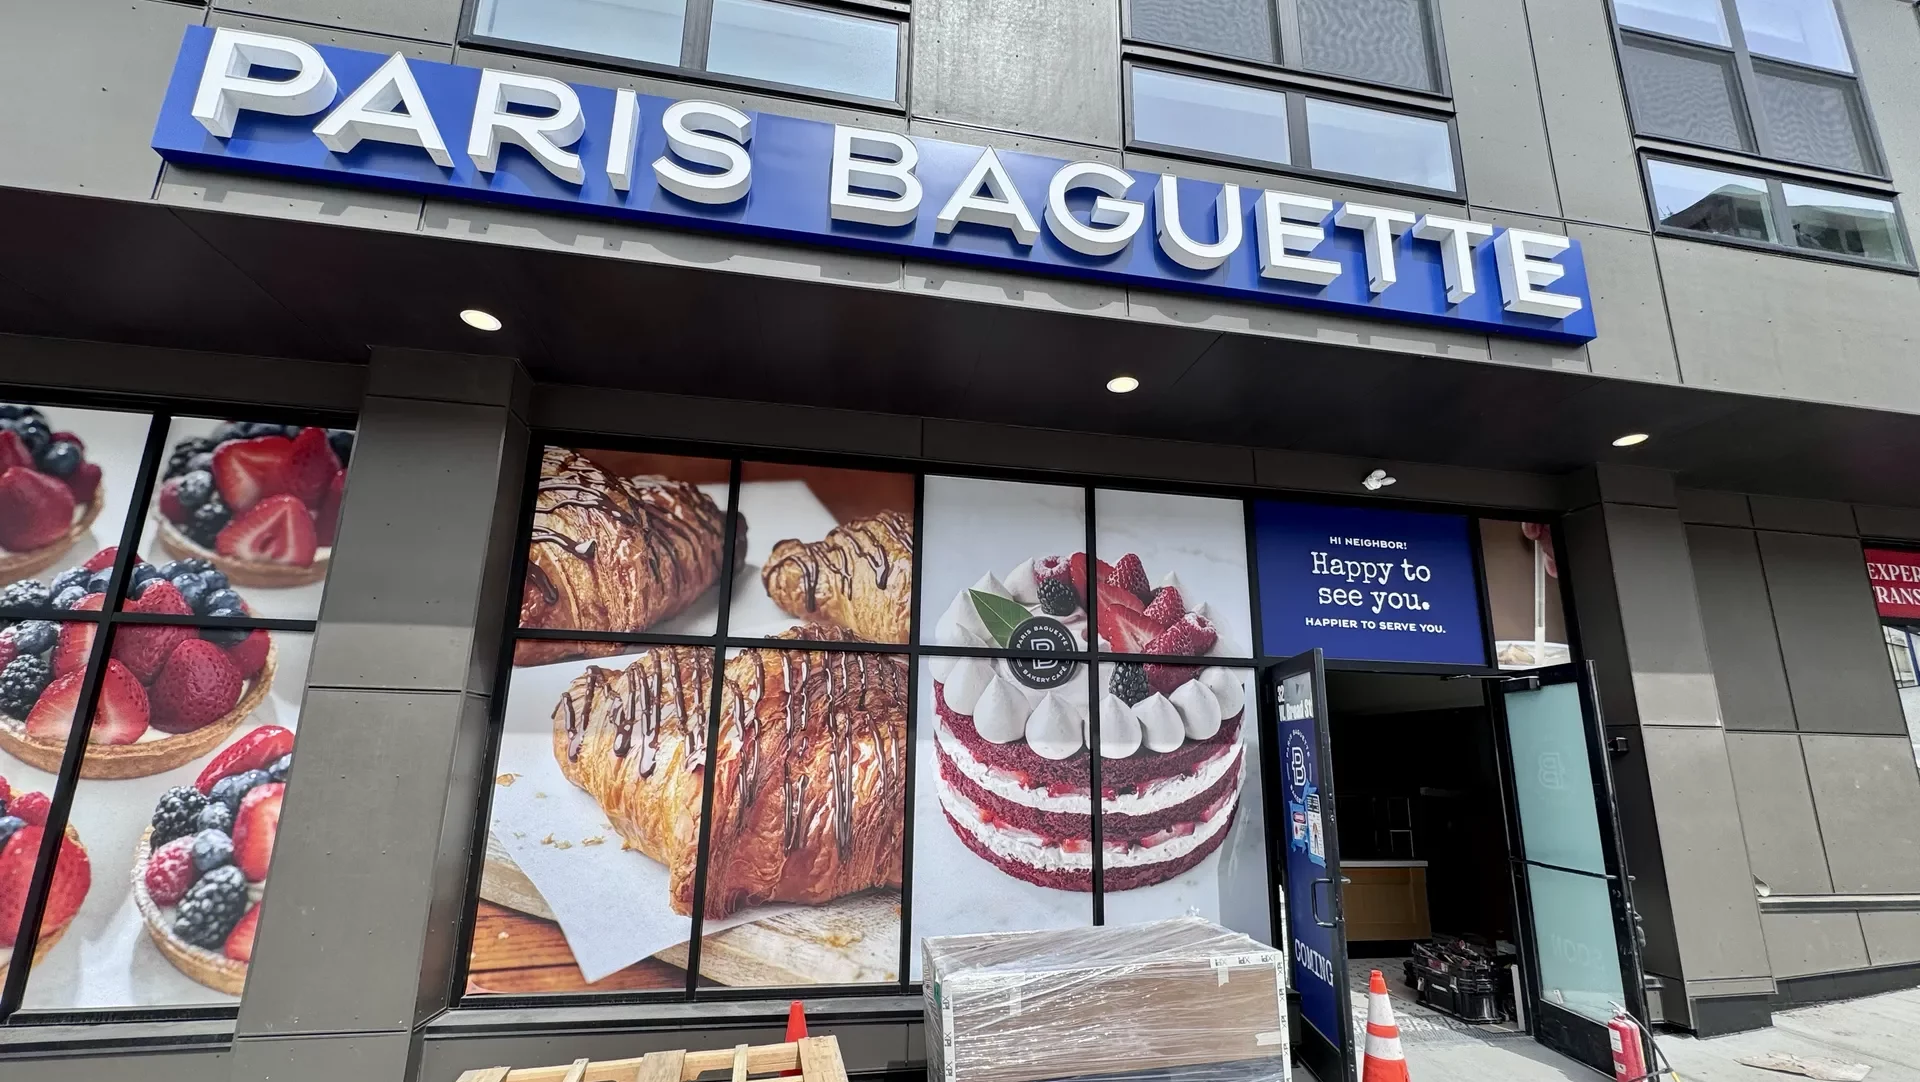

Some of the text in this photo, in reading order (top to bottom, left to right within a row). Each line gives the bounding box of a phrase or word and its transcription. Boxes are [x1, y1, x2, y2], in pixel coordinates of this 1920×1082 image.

[192, 27, 1583, 318] PARIS BAGUETTE
[1330, 536, 1407, 549] HI NEIGHBOR!
[1311, 551, 1431, 585] Happy to
[1318, 587, 1430, 614] see you.
[1872, 585, 1920, 606] RANS
[1016, 625, 1068, 649] PARIS BAGUETTE
[1305, 616, 1446, 634] HAPPIER TO SERVE YOU.
[1022, 669, 1050, 683] BAKERY
[1294, 938, 1334, 987] COMING
